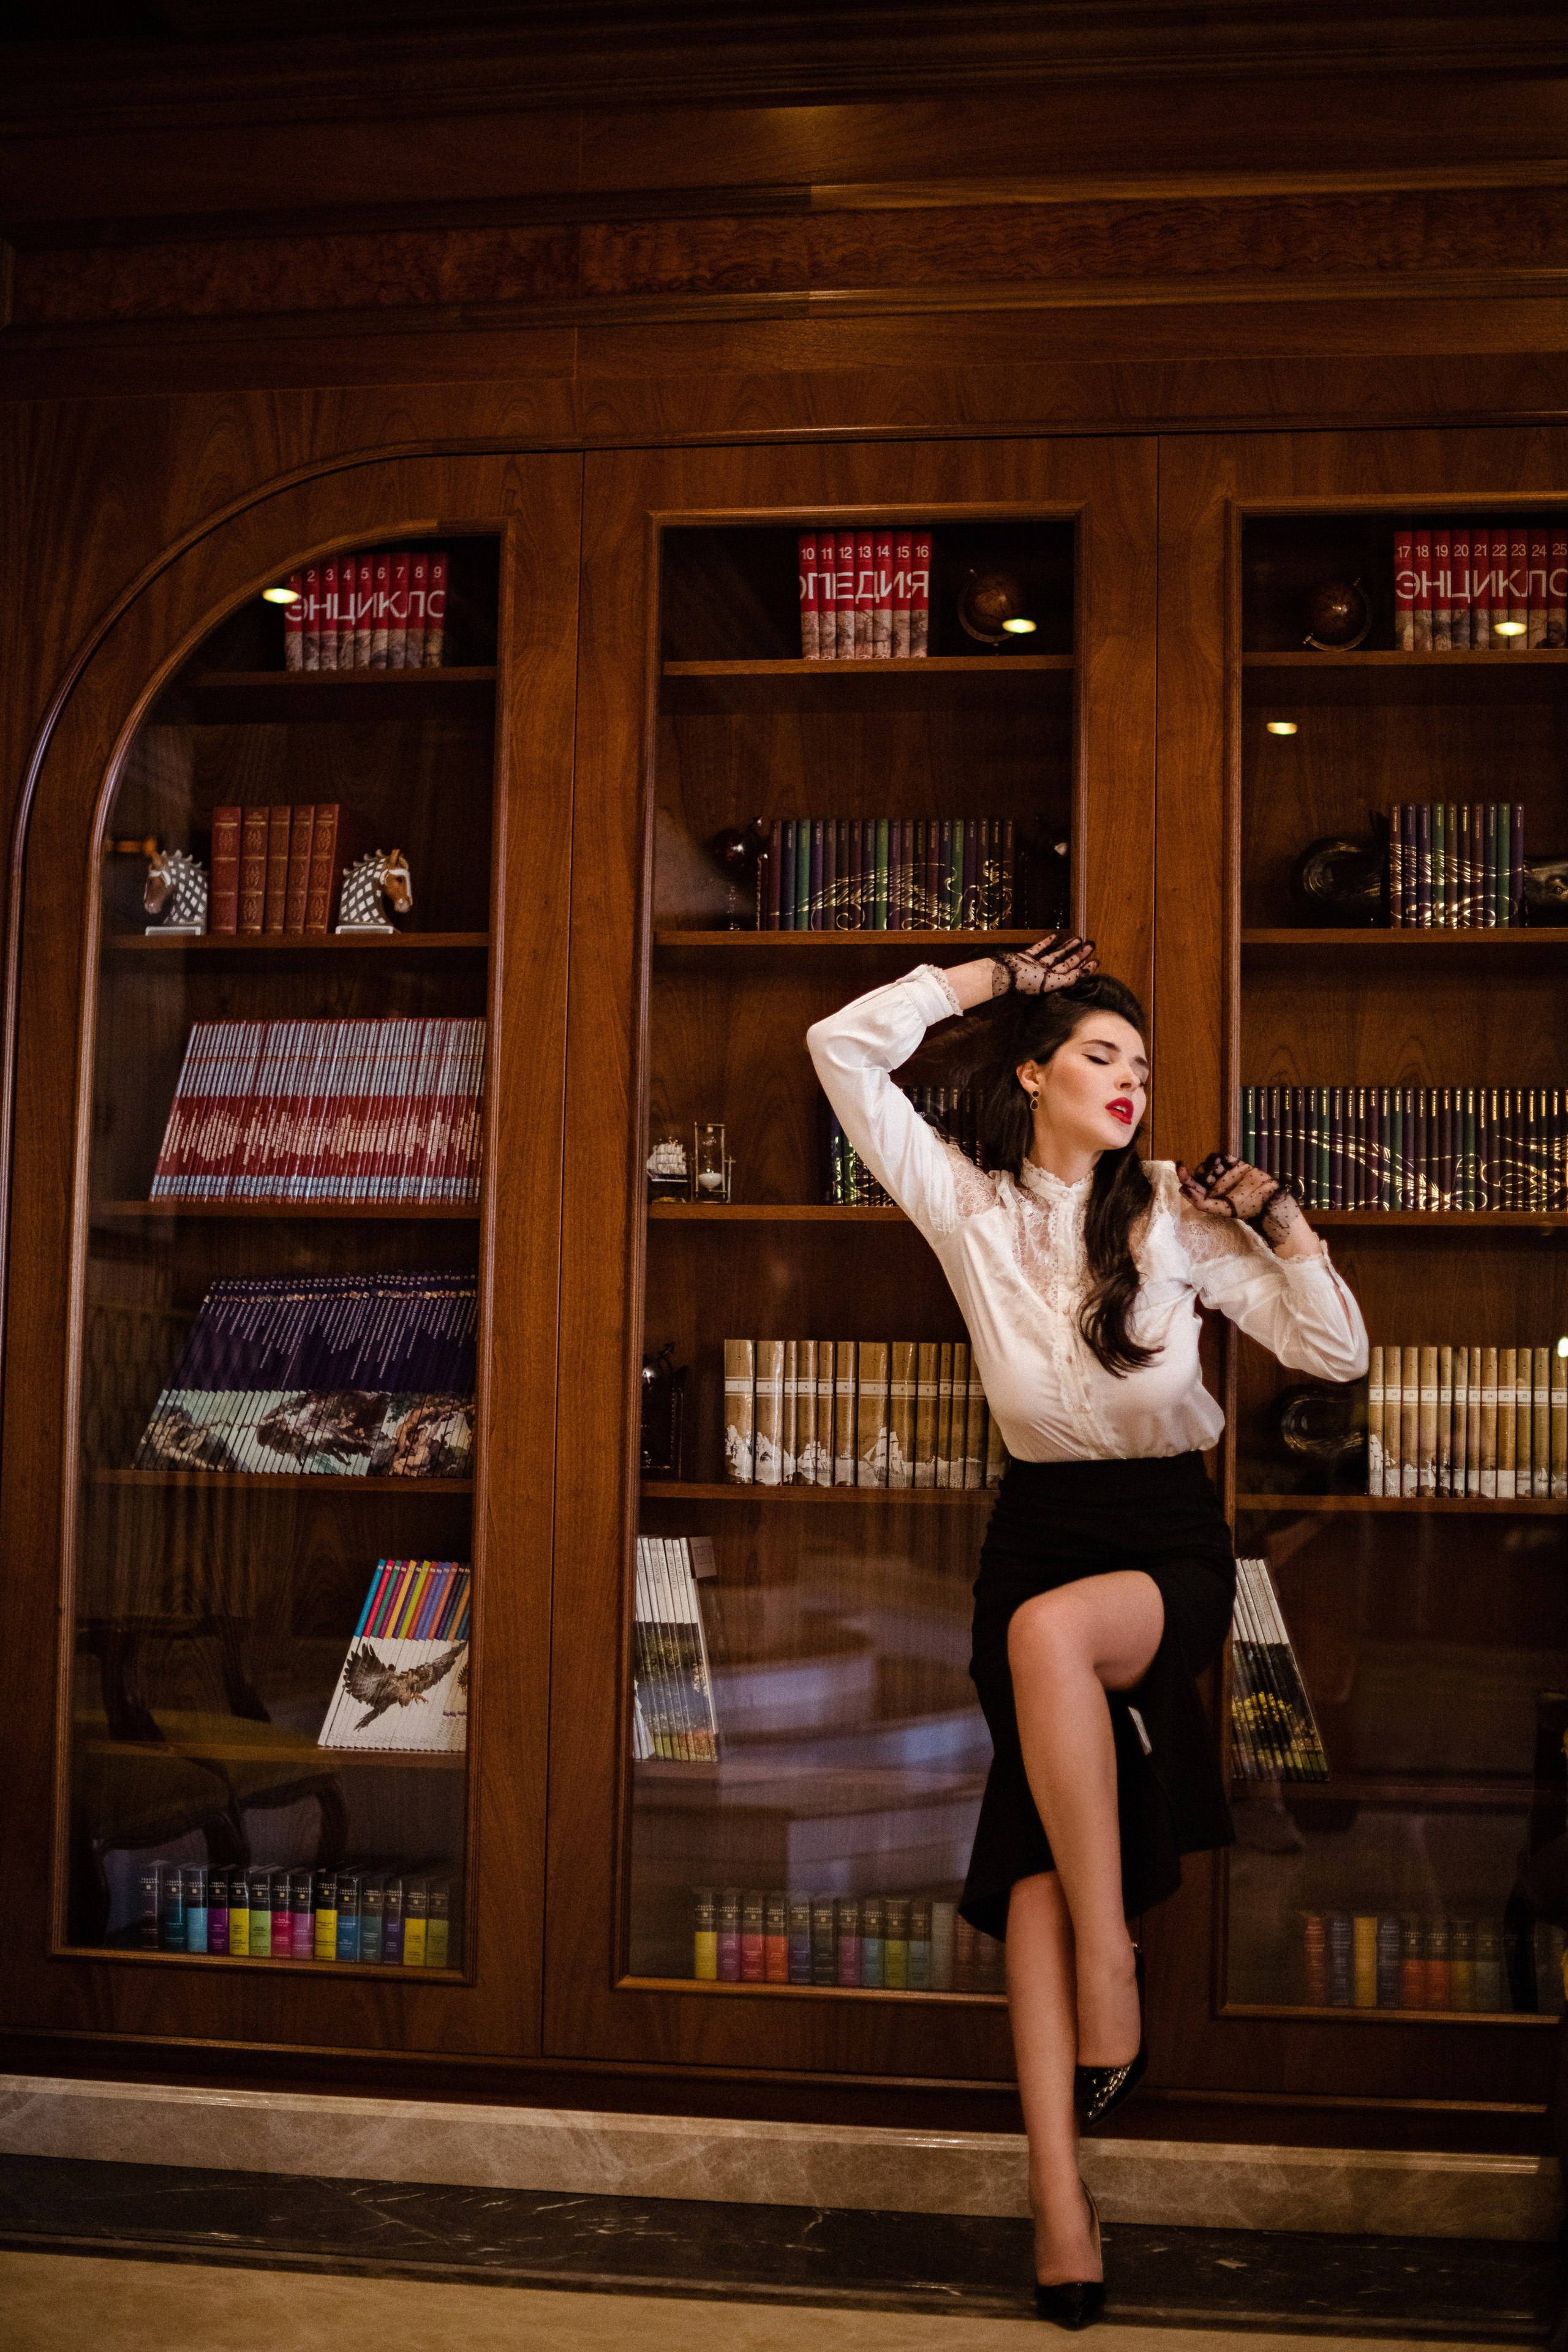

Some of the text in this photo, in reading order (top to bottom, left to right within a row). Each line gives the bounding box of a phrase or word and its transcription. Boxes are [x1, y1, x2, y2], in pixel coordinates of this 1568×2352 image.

[801, 545, 929, 560] 10 11 12 13 14 15 16
[1396, 543, 1567, 558] 17 18 19 20 21 22 23 24 25
[307, 570, 315, 582] 2
[325, 568, 334, 581] 3
[343, 569, 352, 581] 4
[361, 567, 369, 579] 5
[377, 567, 386, 579] 6
[396, 567, 405, 579] 7
[415, 566, 424, 578] 8
[434, 566, 442, 578] 9
